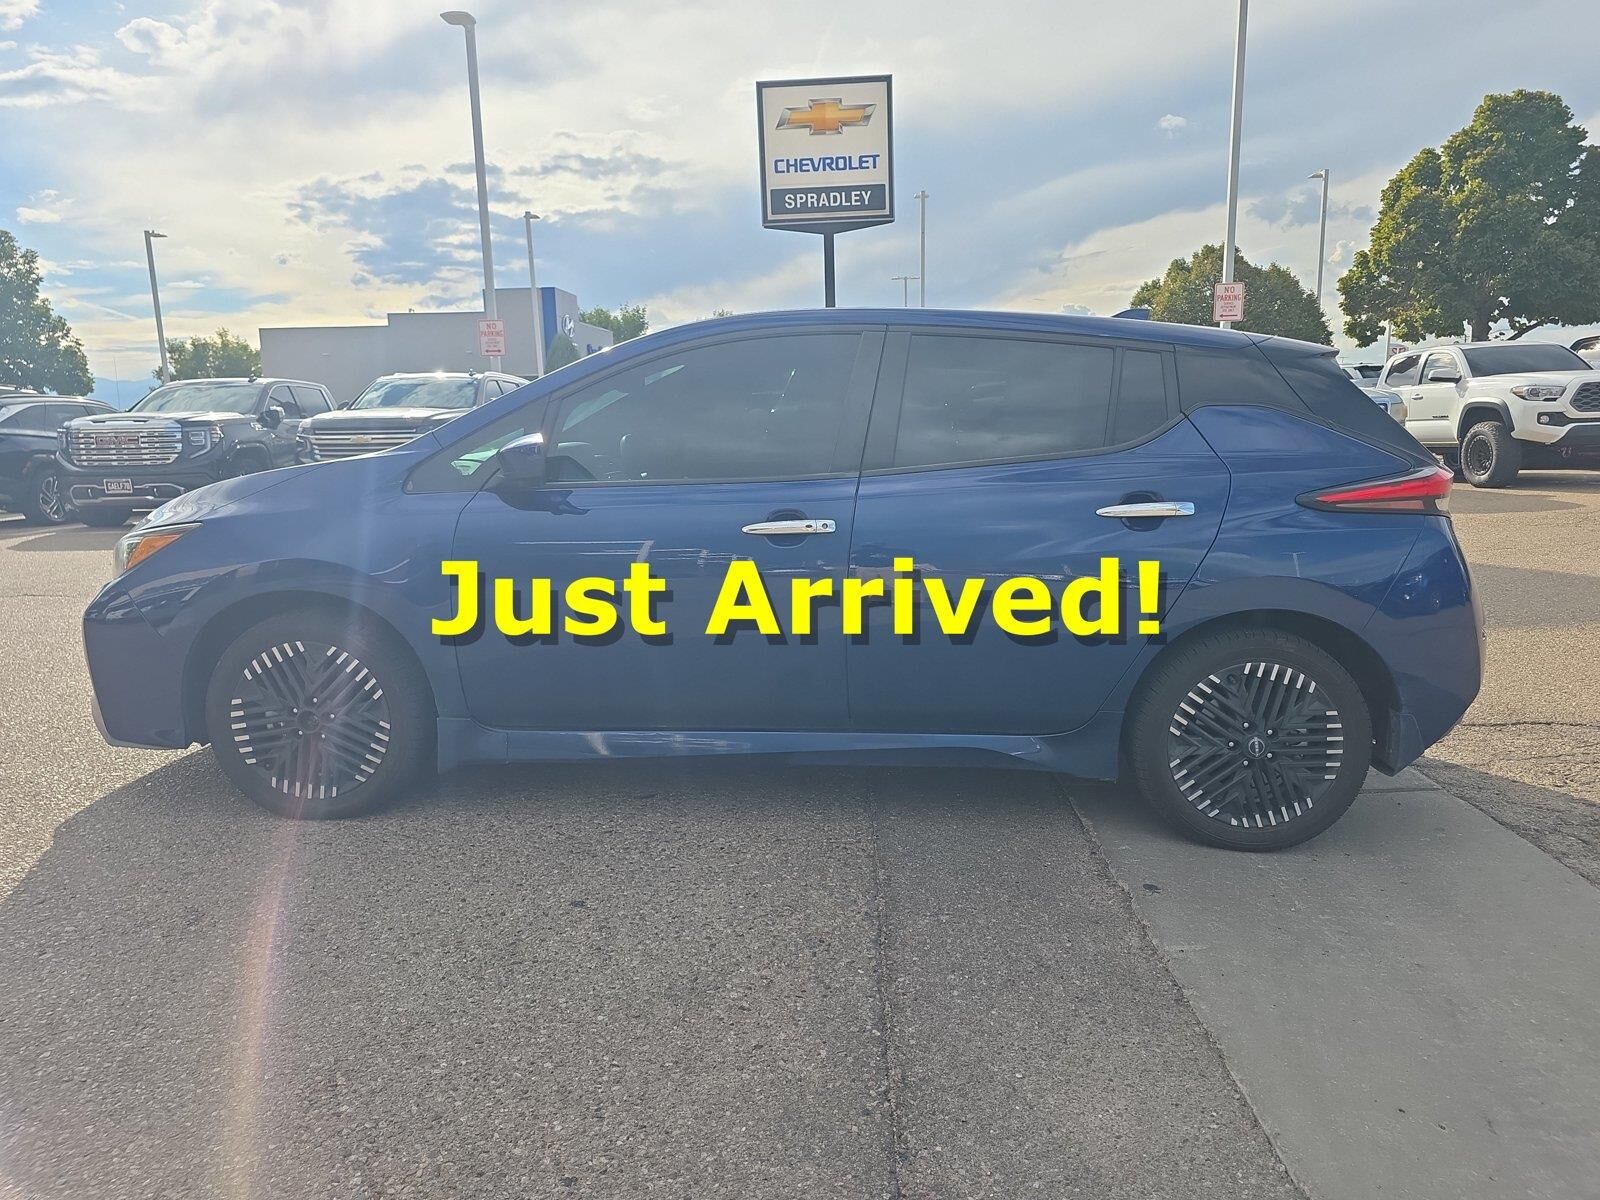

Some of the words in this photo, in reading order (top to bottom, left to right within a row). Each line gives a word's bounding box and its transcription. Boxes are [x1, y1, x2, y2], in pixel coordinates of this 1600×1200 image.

[774, 154, 880, 174] CHEVROLET
[785, 190, 871, 209] SPRADLEY
[1224, 286, 1235, 294] NO
[1217, 294, 1242, 302] PARKING
[96, 435, 139, 446] GMC
